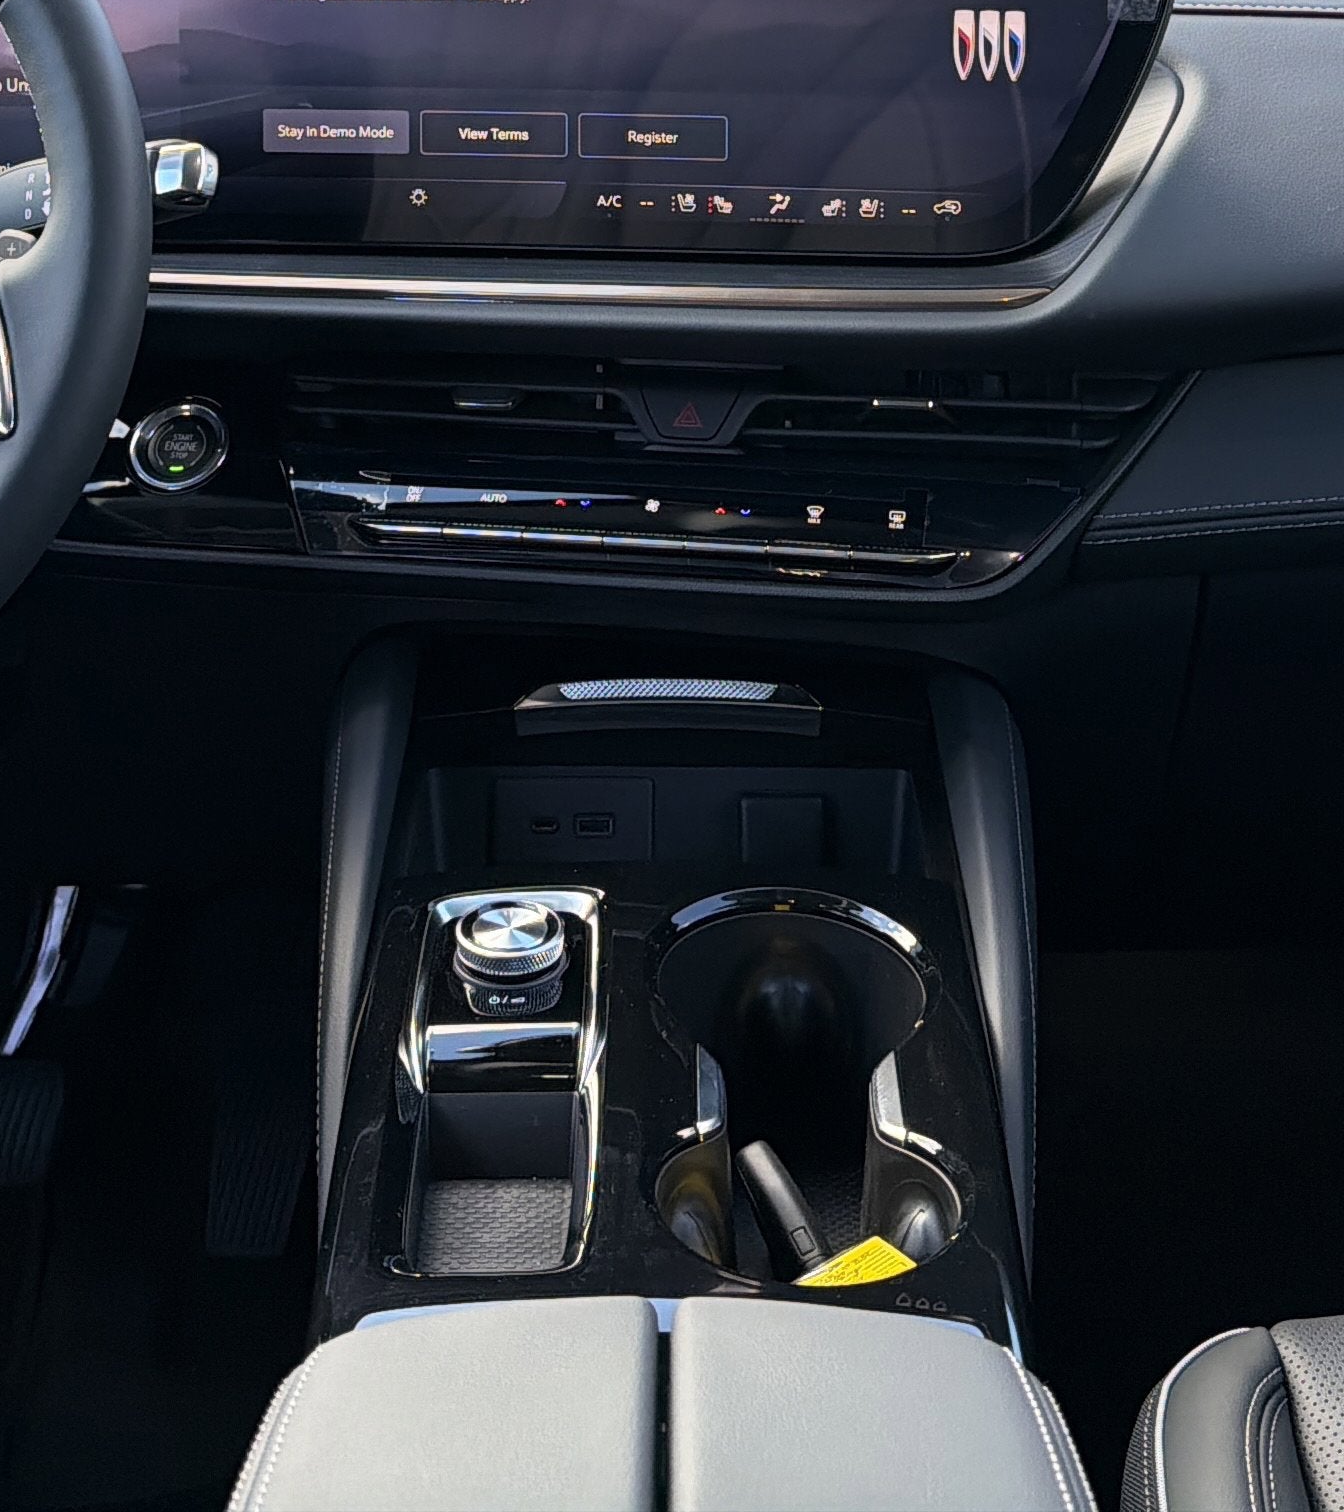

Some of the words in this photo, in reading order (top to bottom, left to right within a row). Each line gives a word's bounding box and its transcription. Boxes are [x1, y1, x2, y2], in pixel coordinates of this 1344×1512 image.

[277, 124, 305, 140] Stay
[306, 125, 318, 139] in
[320, 125, 357, 139] Demo
[359, 125, 395, 139] Mode
[458, 127, 488, 142] View
[491, 128, 529, 142] Terms
[627, 130, 679, 147] Register
[27, 173, 35, 184] R
[25, 190, 33, 201] N
[597, 193, 622, 208] A/C
[173, 433, 194, 441] START
[165, 440, 198, 452] ENGINE
[171, 451, 189, 459] STOP
[480, 492, 508, 504] AUTO
